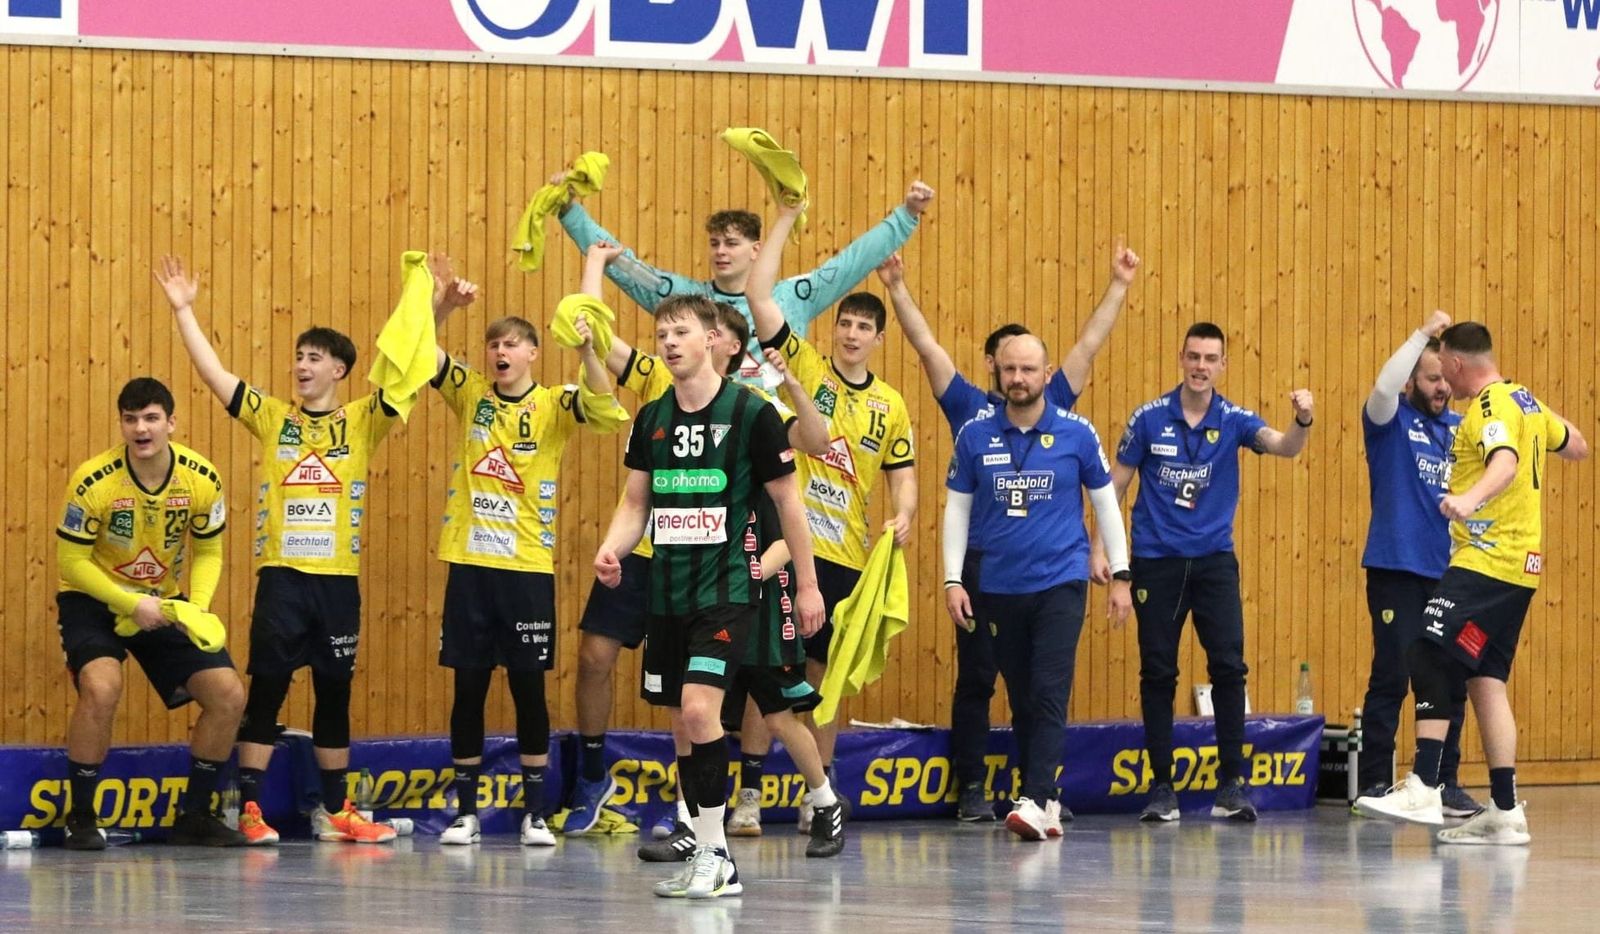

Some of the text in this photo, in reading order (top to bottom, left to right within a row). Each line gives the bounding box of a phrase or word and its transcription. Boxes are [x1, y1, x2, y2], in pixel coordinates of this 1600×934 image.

[329, 418, 346, 446] 17
[519, 411, 530, 438] 6
[868, 410, 886, 439] 15
[673, 425, 705, 458] 35
[299, 465, 322, 481] WTG
[487, 458, 506, 476] WTG
[671, 472, 720, 489] pharma
[810, 479, 836, 498] BGV
[540, 483, 556, 497] SAP
[1011, 490, 1023, 506] B
[1182, 482, 1195, 498] C
[287, 505, 316, 516] BGV
[473, 498, 499, 510] BGV
[165, 509, 189, 538] 23
[657, 508, 723, 531] enercity
[133, 562, 156, 576] WTG
